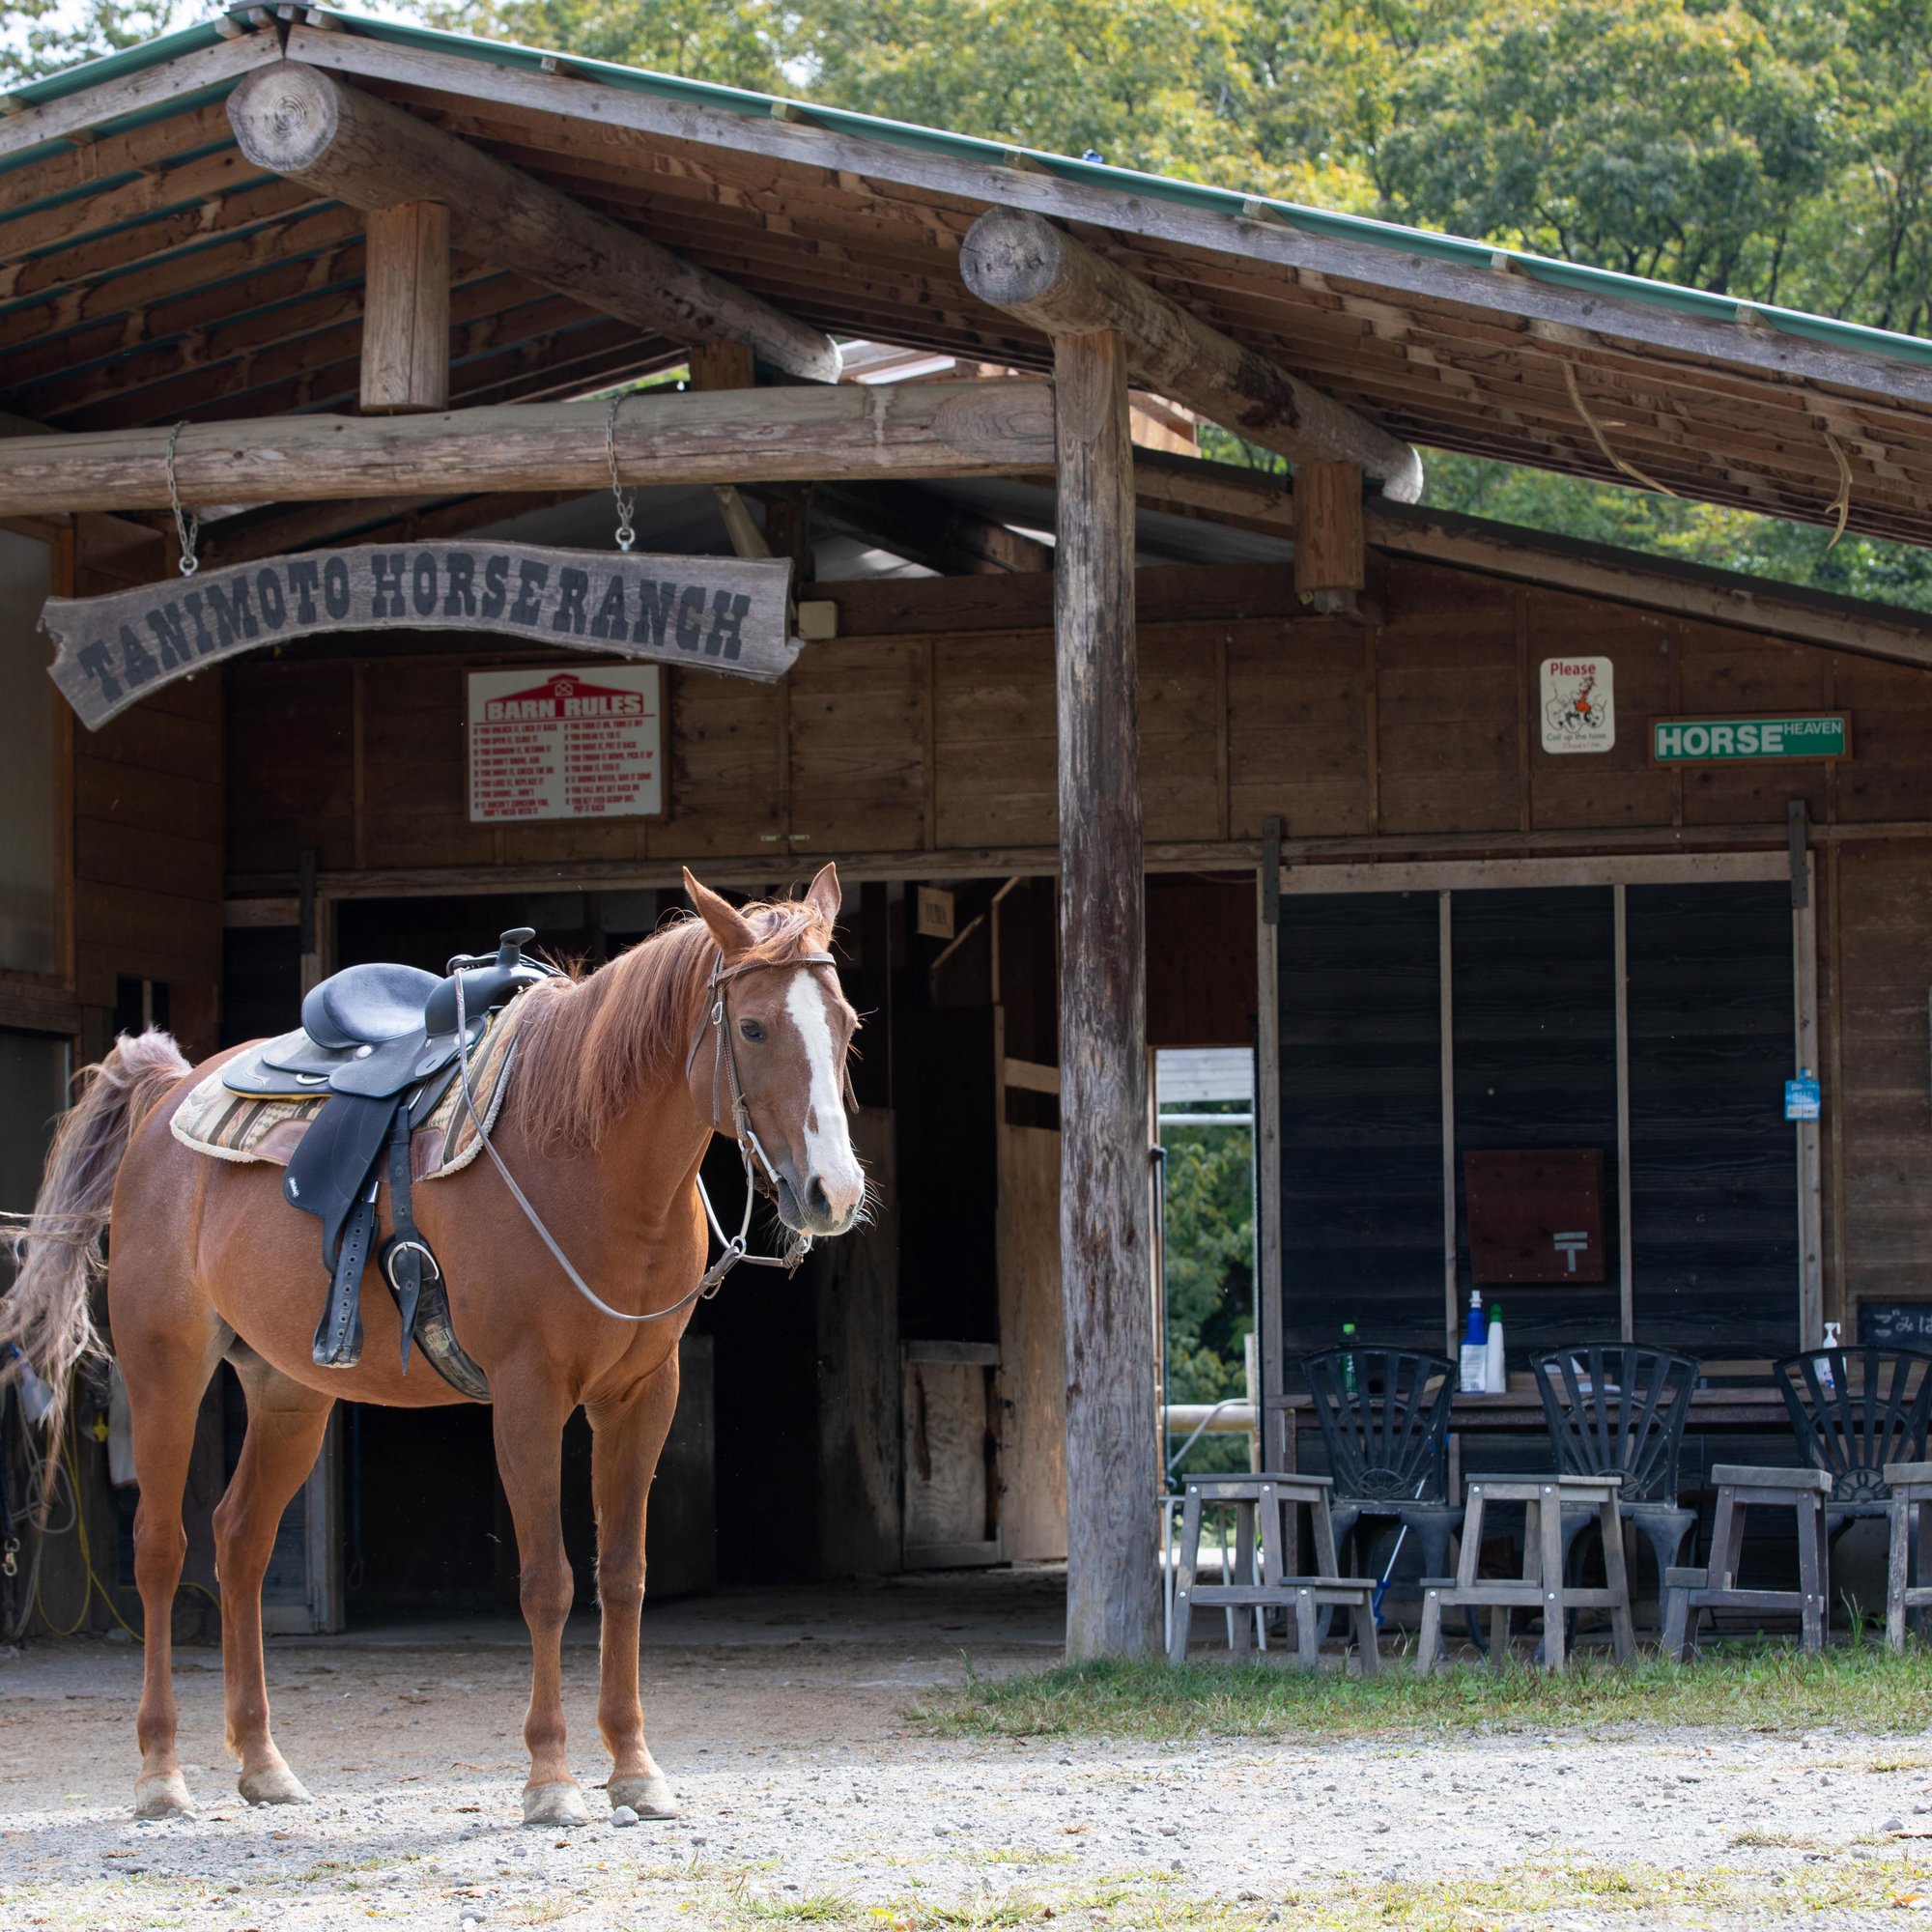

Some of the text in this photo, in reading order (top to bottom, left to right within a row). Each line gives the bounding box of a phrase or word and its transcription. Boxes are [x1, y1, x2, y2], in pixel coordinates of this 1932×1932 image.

[76, 553, 751, 703] TANIMOTO HORSE RANCH
[1550, 662, 1596, 675] Please
[488, 696, 641, 720] BARN RULES
[1658, 724, 1784, 755] HORSE
[1784, 722, 1841, 735] HEAVEN
